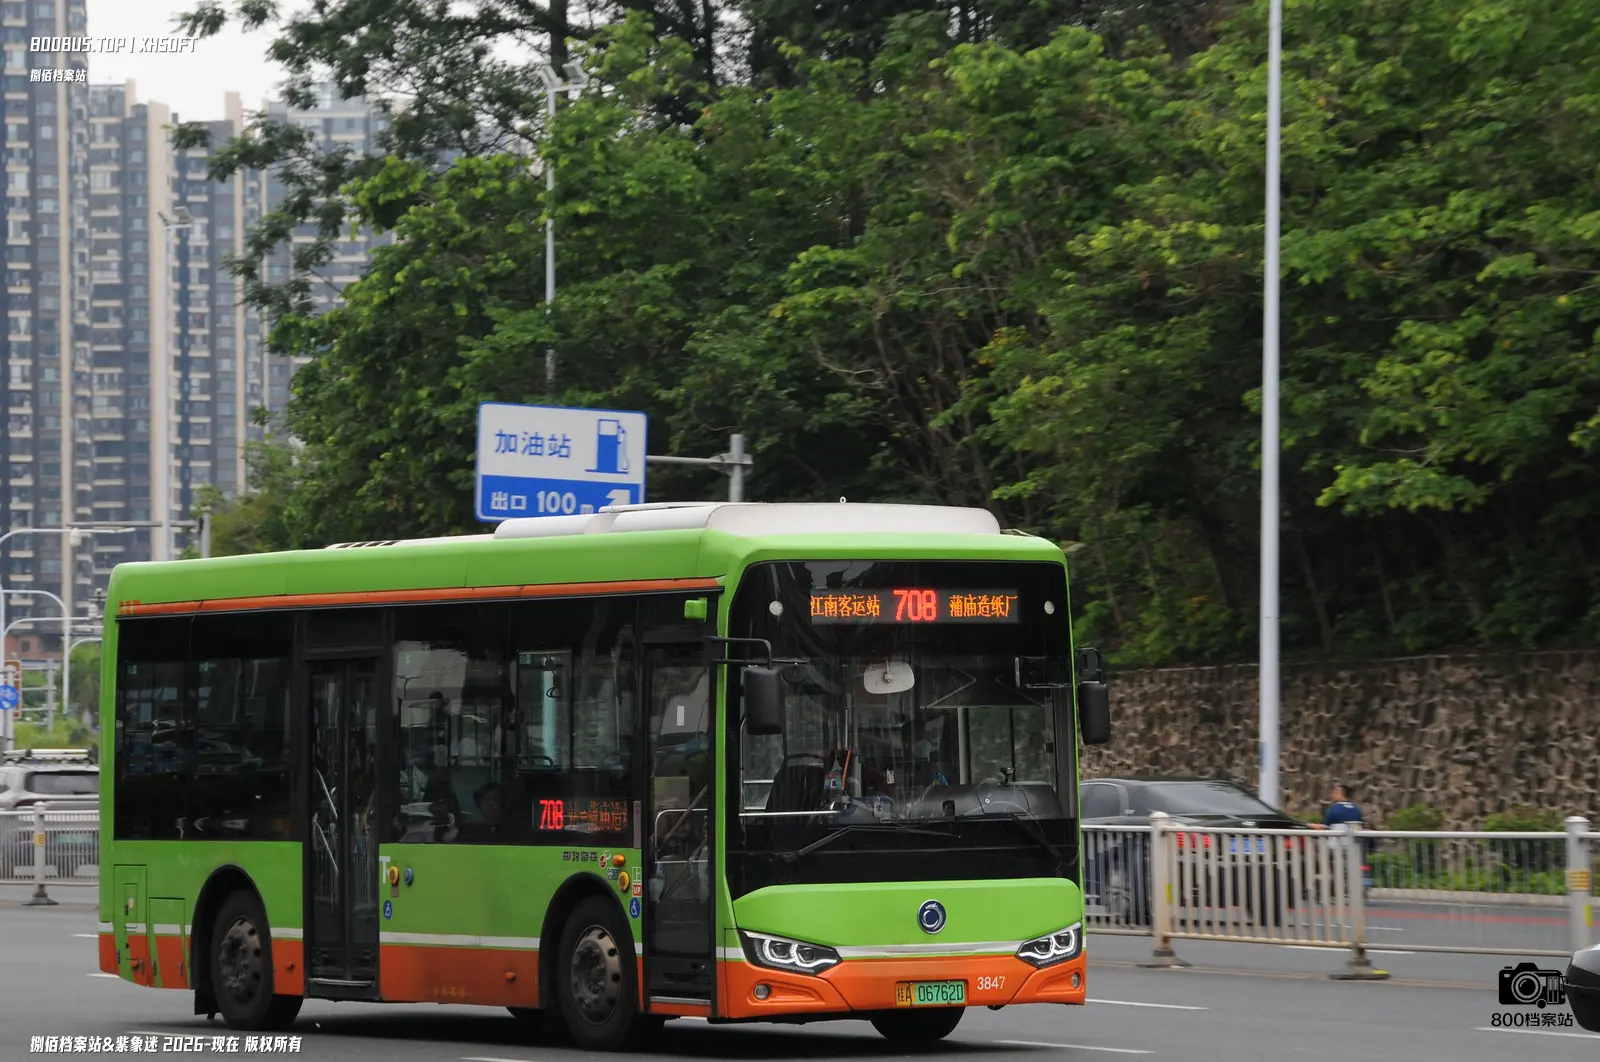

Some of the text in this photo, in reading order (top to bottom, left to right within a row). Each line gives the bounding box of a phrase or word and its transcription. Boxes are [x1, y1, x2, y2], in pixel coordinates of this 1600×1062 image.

[495, 429, 571, 458] 加油站
[490, 491, 527, 511] 出口
[537, 490, 577, 514] 100
[810, 589, 1018, 621] 江南客运站 708 蒲庙造纸厂
[539, 799, 564, 830] 708
[633, 886, 641, 895] UP
[918, 984, 964, 1002] 06762D
[977, 976, 1006, 990] 3847
